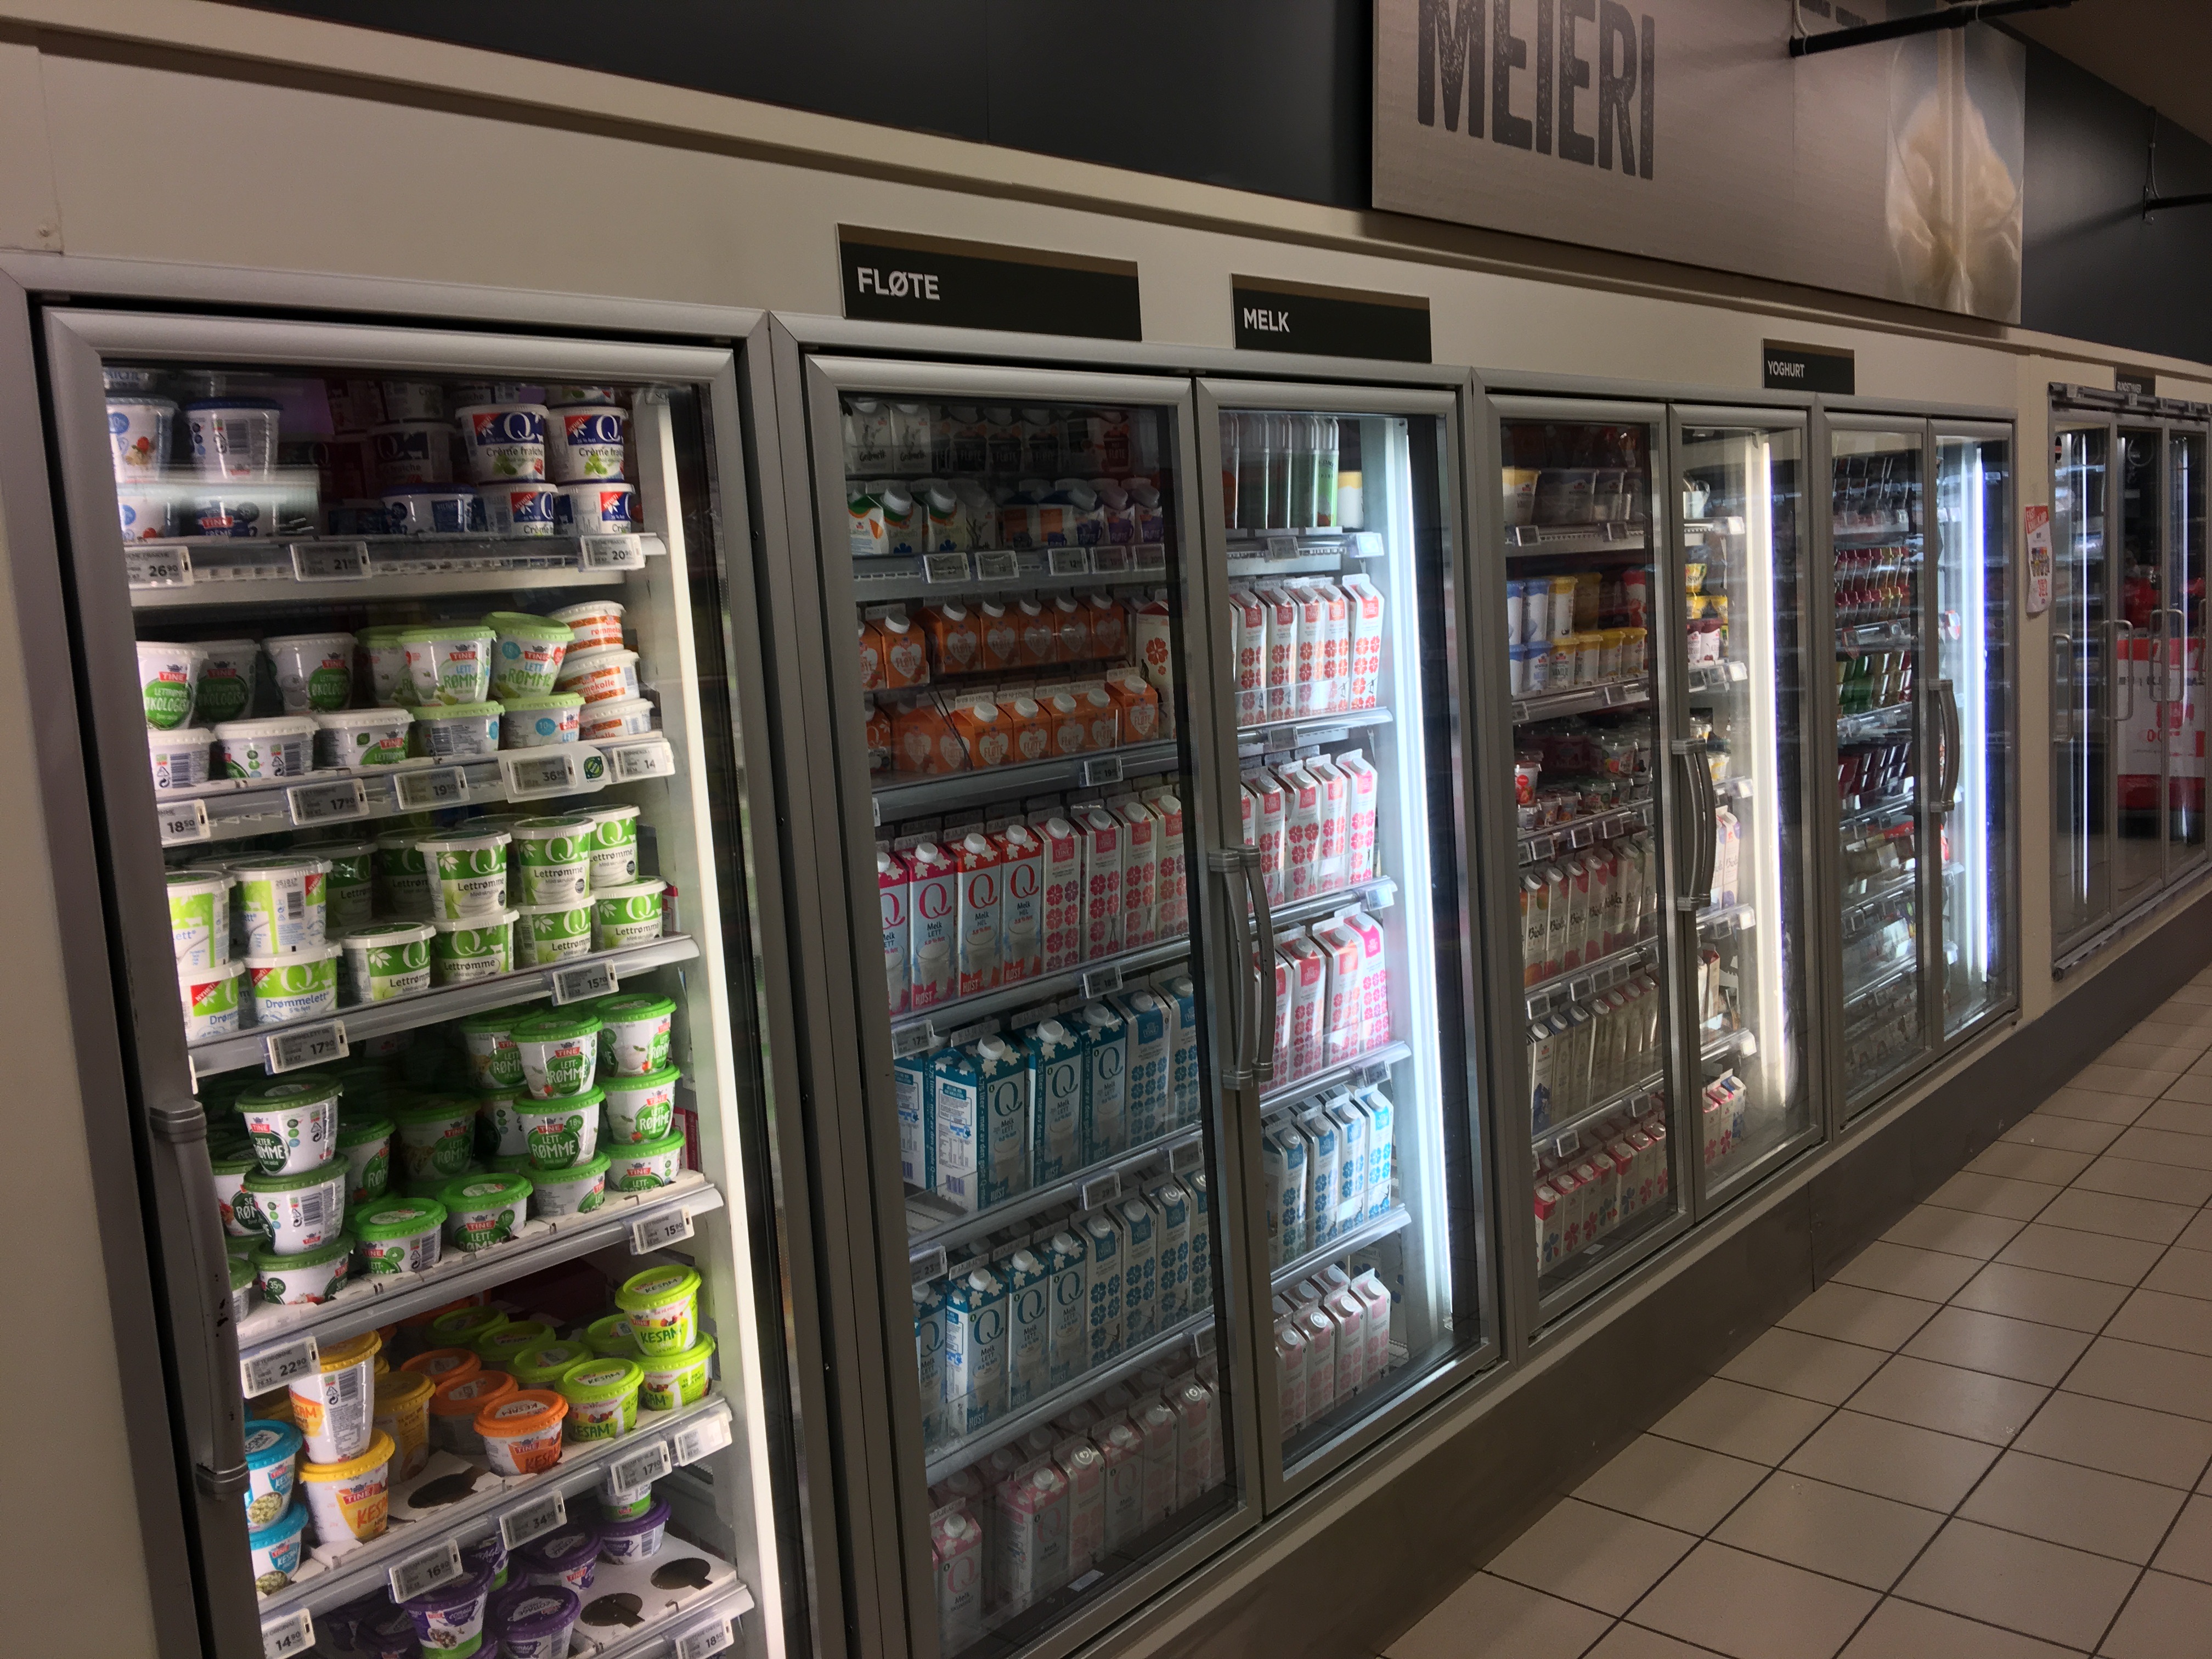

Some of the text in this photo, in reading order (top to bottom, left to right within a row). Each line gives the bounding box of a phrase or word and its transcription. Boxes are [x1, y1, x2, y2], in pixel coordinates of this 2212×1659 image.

[1418, 0, 1655, 180] MEIERI
[857, 267, 941, 301] FLØTE
[1243, 307, 1290, 334] MELK
[1767, 359, 1805, 379] YOGHURT
[503, 412, 535, 441] Q
[596, 414, 620, 442] Q
[162, 673, 184, 681] TINE
[507, 668, 552, 687] RØMME
[576, 679, 615, 693] mmekolle
[382, 739, 403, 748] TINE
[167, 819, 195, 834] 1850
[596, 820, 628, 847] Q
[545, 836, 578, 863] Q
[470, 845, 500, 874] Q
[534, 866, 583, 878] Lettrømme
[457, 877, 505, 892] Lettrømme
[1010, 863, 1040, 899] Q
[968, 873, 998, 910] Q
[626, 895, 655, 921] Q
[919, 882, 952, 919] Q
[1017, 901, 1031, 910] Melk
[563, 909, 589, 934] Q
[975, 911, 989, 921] Melk
[615, 922, 659, 936] Lettrømme
[927, 921, 943, 931] Melk
[928, 929, 942, 938] LETT
[451, 929, 487, 956] Q
[551, 937, 591, 951] Lettrømm
[403, 940, 428, 969] Q
[444, 959, 495, 971] Lettrømme
[280, 964, 318, 993] Q
[390, 972, 430, 988] Lettrømm
[1006, 967, 1022, 980] HØST
[194, 983, 216, 1001] NYHET!
[962, 978, 980, 993] HØST
[266, 994, 327, 1009] Drømmelett
[915, 990, 933, 1005] HØST
[558, 1048, 578, 1057] TINE
[561, 1059, 578, 1069] LETT-
[1098, 1046, 1124, 1081] Q
[1052, 1064, 1079, 1099] Q
[1104, 1081, 1115, 1091] Melk
[649, 1095, 666, 1105] TINE
[994, 1081, 1023, 1116] Q
[1057, 1099, 1070, 1109] Melk
[1058, 1105, 1070, 1115] LETT
[639, 1110, 670, 1131] RØMME
[1001, 1118, 1014, 1127] Melk
[540, 1125, 563, 1133] TINE
[1002, 1126, 1014, 1135] LETT
[255, 1137, 274, 1146] SETER-
[542, 1135, 563, 1145] LETT-
[531, 1139, 575, 1159] RØMME
[632, 1178, 649, 1187] LETT-
[990, 1186, 1006, 1201] HØST
[469, 1221, 493, 1230] TINE
[471, 1232, 494, 1243] LETT-
[645, 1278, 678, 1293] KESAM
[1057, 1271, 1085, 1306] Q
[1017, 1289, 1046, 1324] Q
[1063, 1306, 1076, 1316] Melk
[974, 1308, 1005, 1345] Q
[1023, 1324, 1037, 1335] Melk
[640, 1328, 682, 1343] KESAM
[1024, 1333, 1036, 1342] LETT
[980, 1345, 995, 1356] Melk
[981, 1353, 995, 1363] LETT
[279, 1358, 307, 1376] 2290
[588, 1372, 620, 1384] KESAM
[968, 1412, 985, 1427] HØST
[1044, 1542, 1057, 1553] Melk
[947, 1556, 979, 1594] Q
[954, 1591, 969, 1604] Melk
[275, 1631, 301, 1650] 1490
[706, 1632, 724, 1647] 1850
